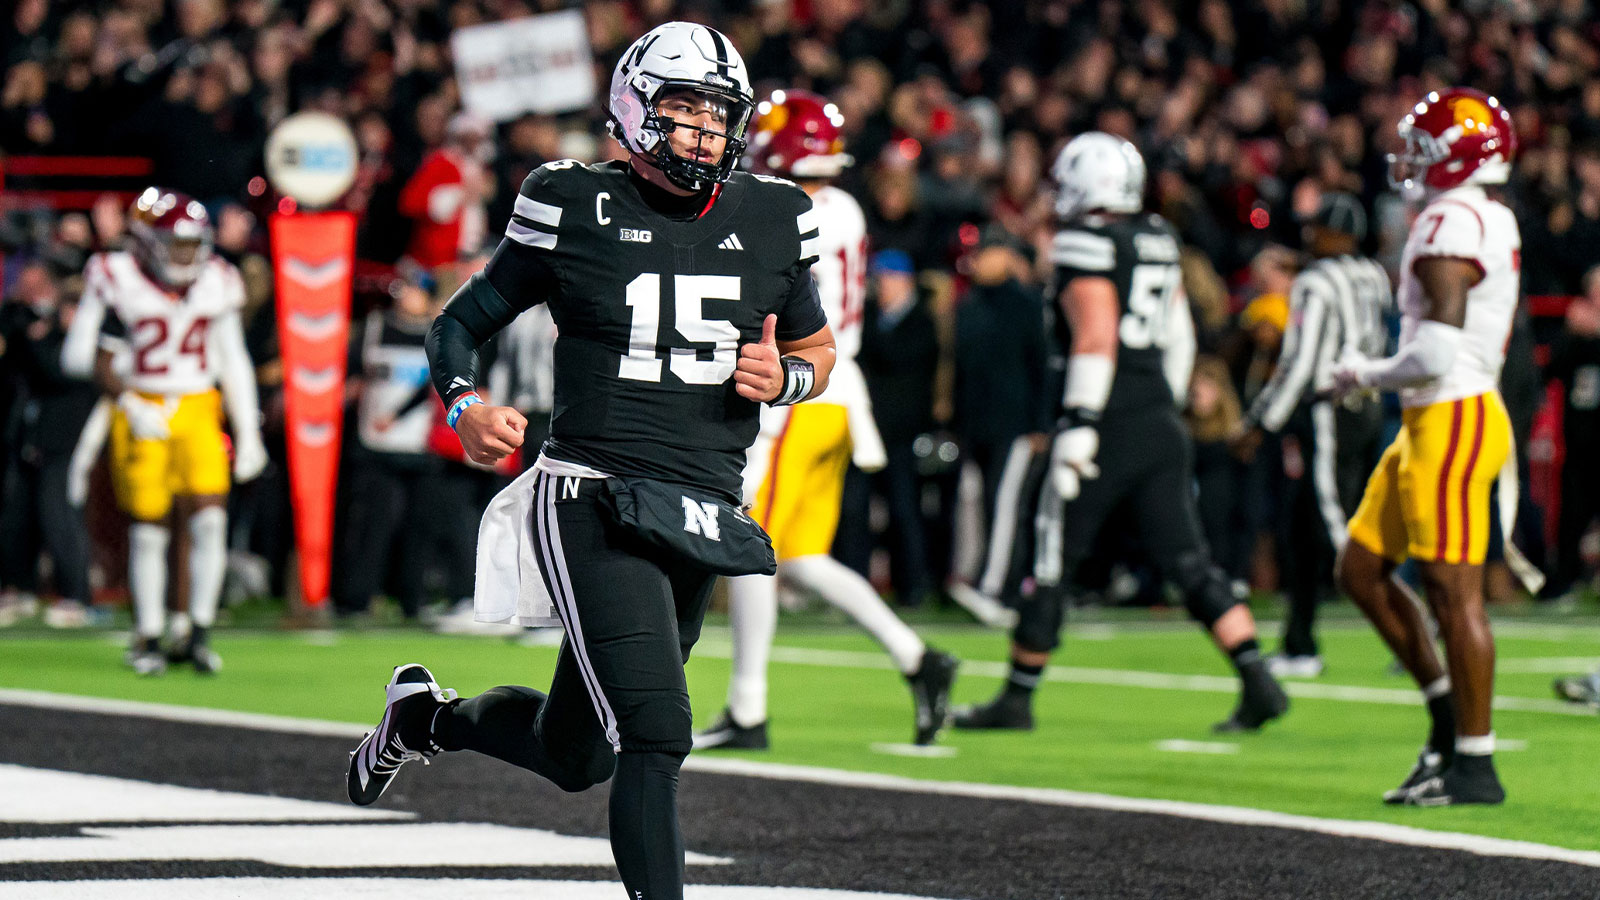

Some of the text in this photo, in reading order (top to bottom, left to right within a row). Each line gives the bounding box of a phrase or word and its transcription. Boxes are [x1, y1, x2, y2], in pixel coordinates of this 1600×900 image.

[596, 191, 611, 226] C
[1426, 214, 1445, 245] 7
[135, 315, 211, 376] 24
[618, 272, 741, 385] 15
[562, 476, 581, 500] N
[681, 495, 720, 541] N
